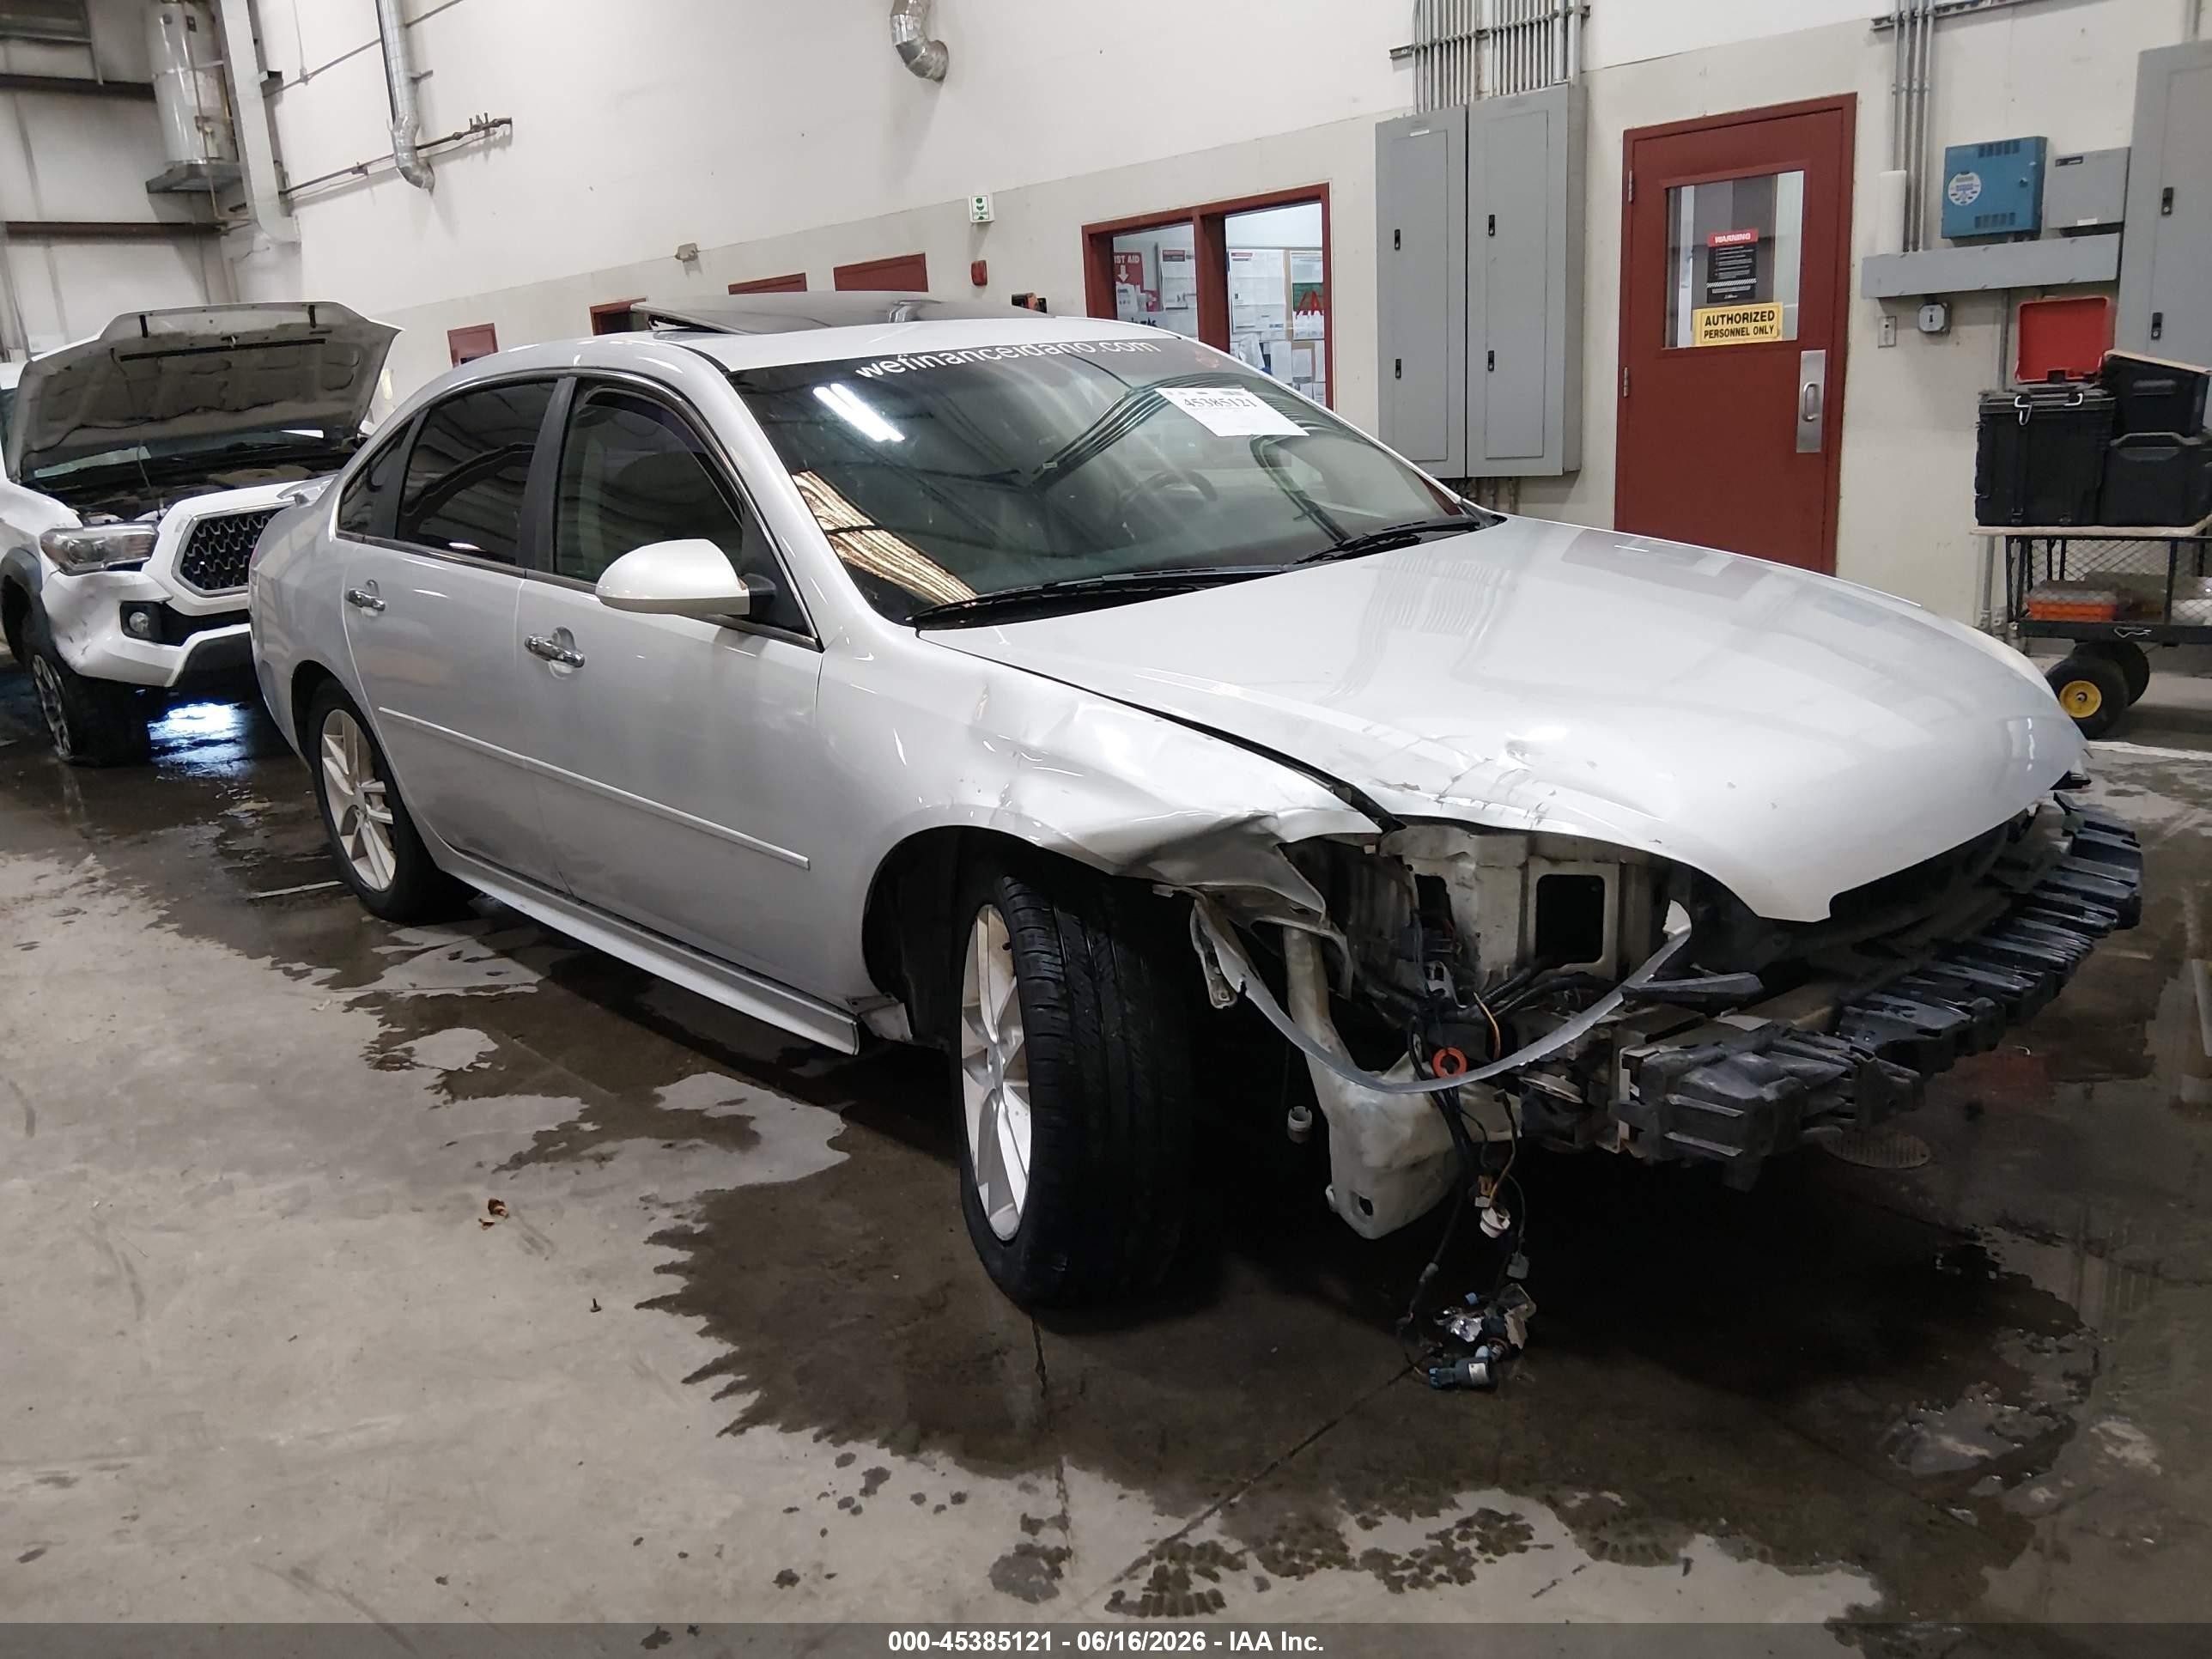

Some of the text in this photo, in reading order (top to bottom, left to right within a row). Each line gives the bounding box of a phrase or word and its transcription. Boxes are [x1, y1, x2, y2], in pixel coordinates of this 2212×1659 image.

[1714, 233, 1751, 244] WARNING
[1127, 254, 1140, 264] AID
[1705, 310, 1775, 326] AUTHORIZED
[1704, 325, 1775, 338] PERSONNEL ONLY
[1183, 398, 1258, 408] 45385121
